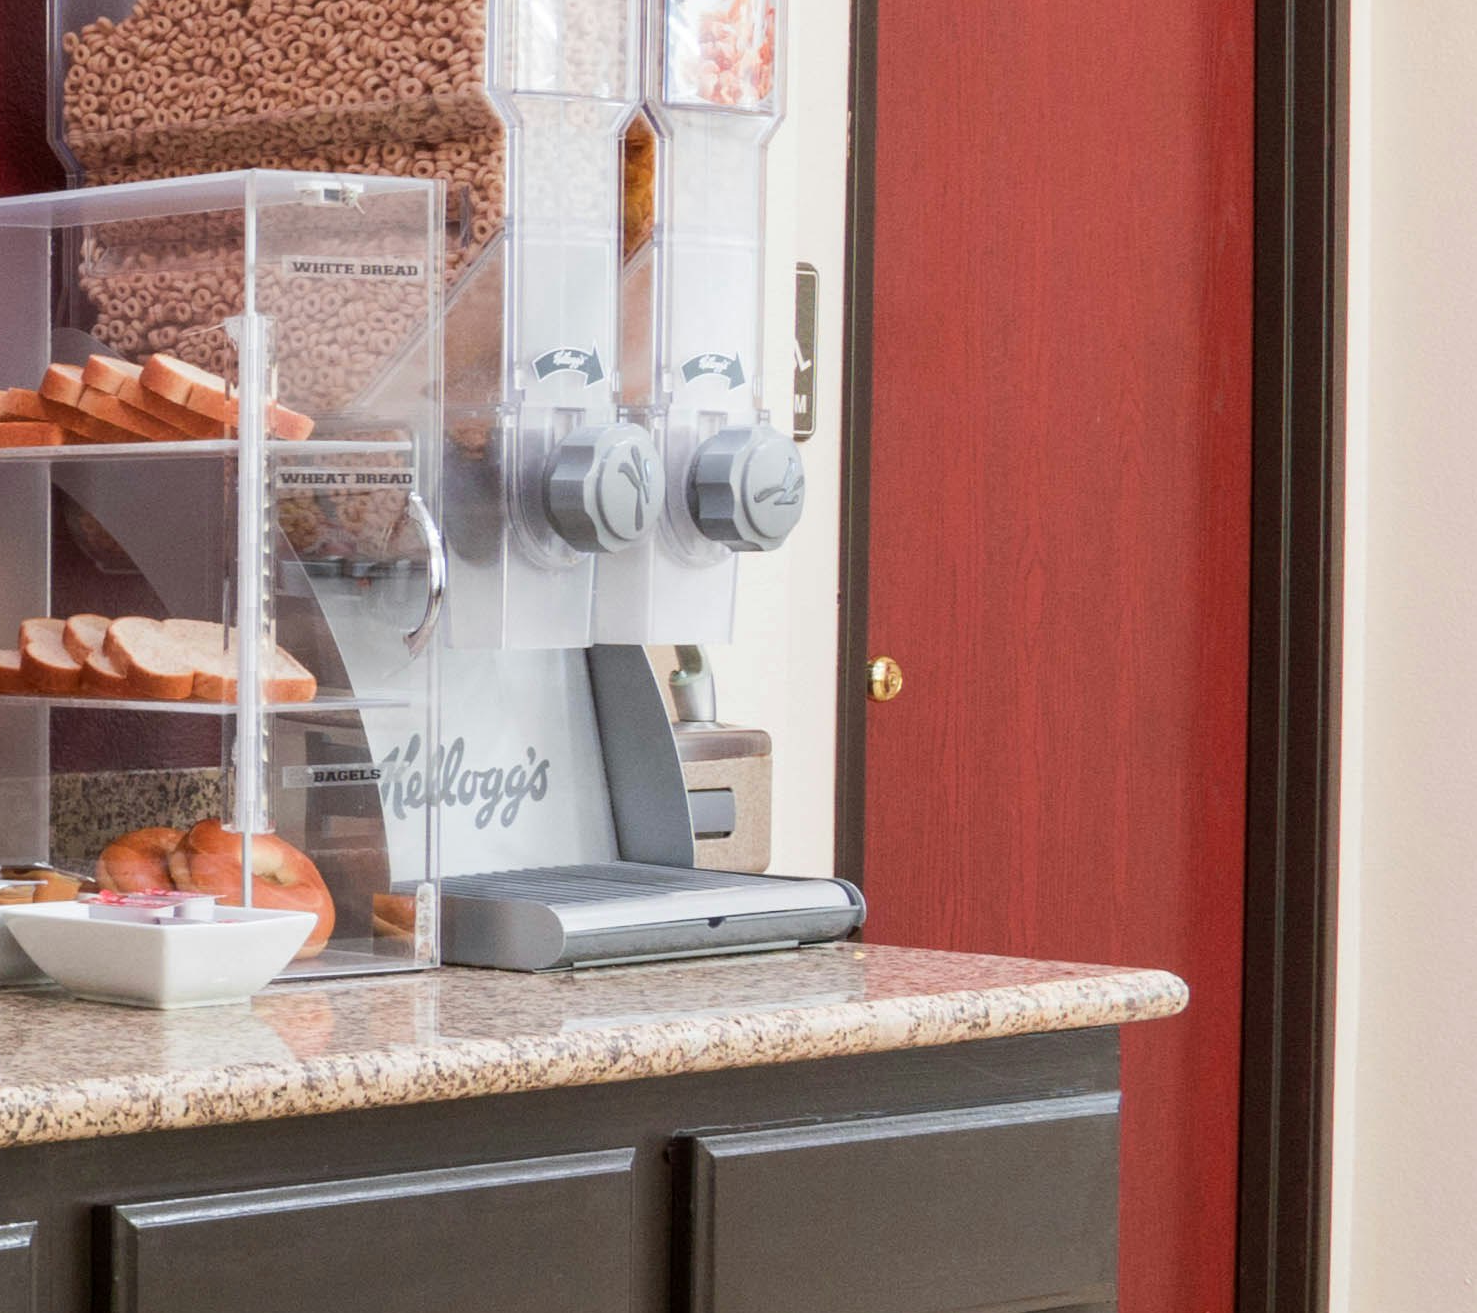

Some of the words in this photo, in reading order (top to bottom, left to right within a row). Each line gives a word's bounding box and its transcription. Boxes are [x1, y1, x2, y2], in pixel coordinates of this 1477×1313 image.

[292, 260, 355, 275] WHITE
[360, 264, 419, 277] BREAD
[280, 472, 351, 485] WHEAT
[355, 472, 413, 485] BREAD
[312, 768, 382, 783] BAGELS
[379, 733, 550, 830] Kellogg's
